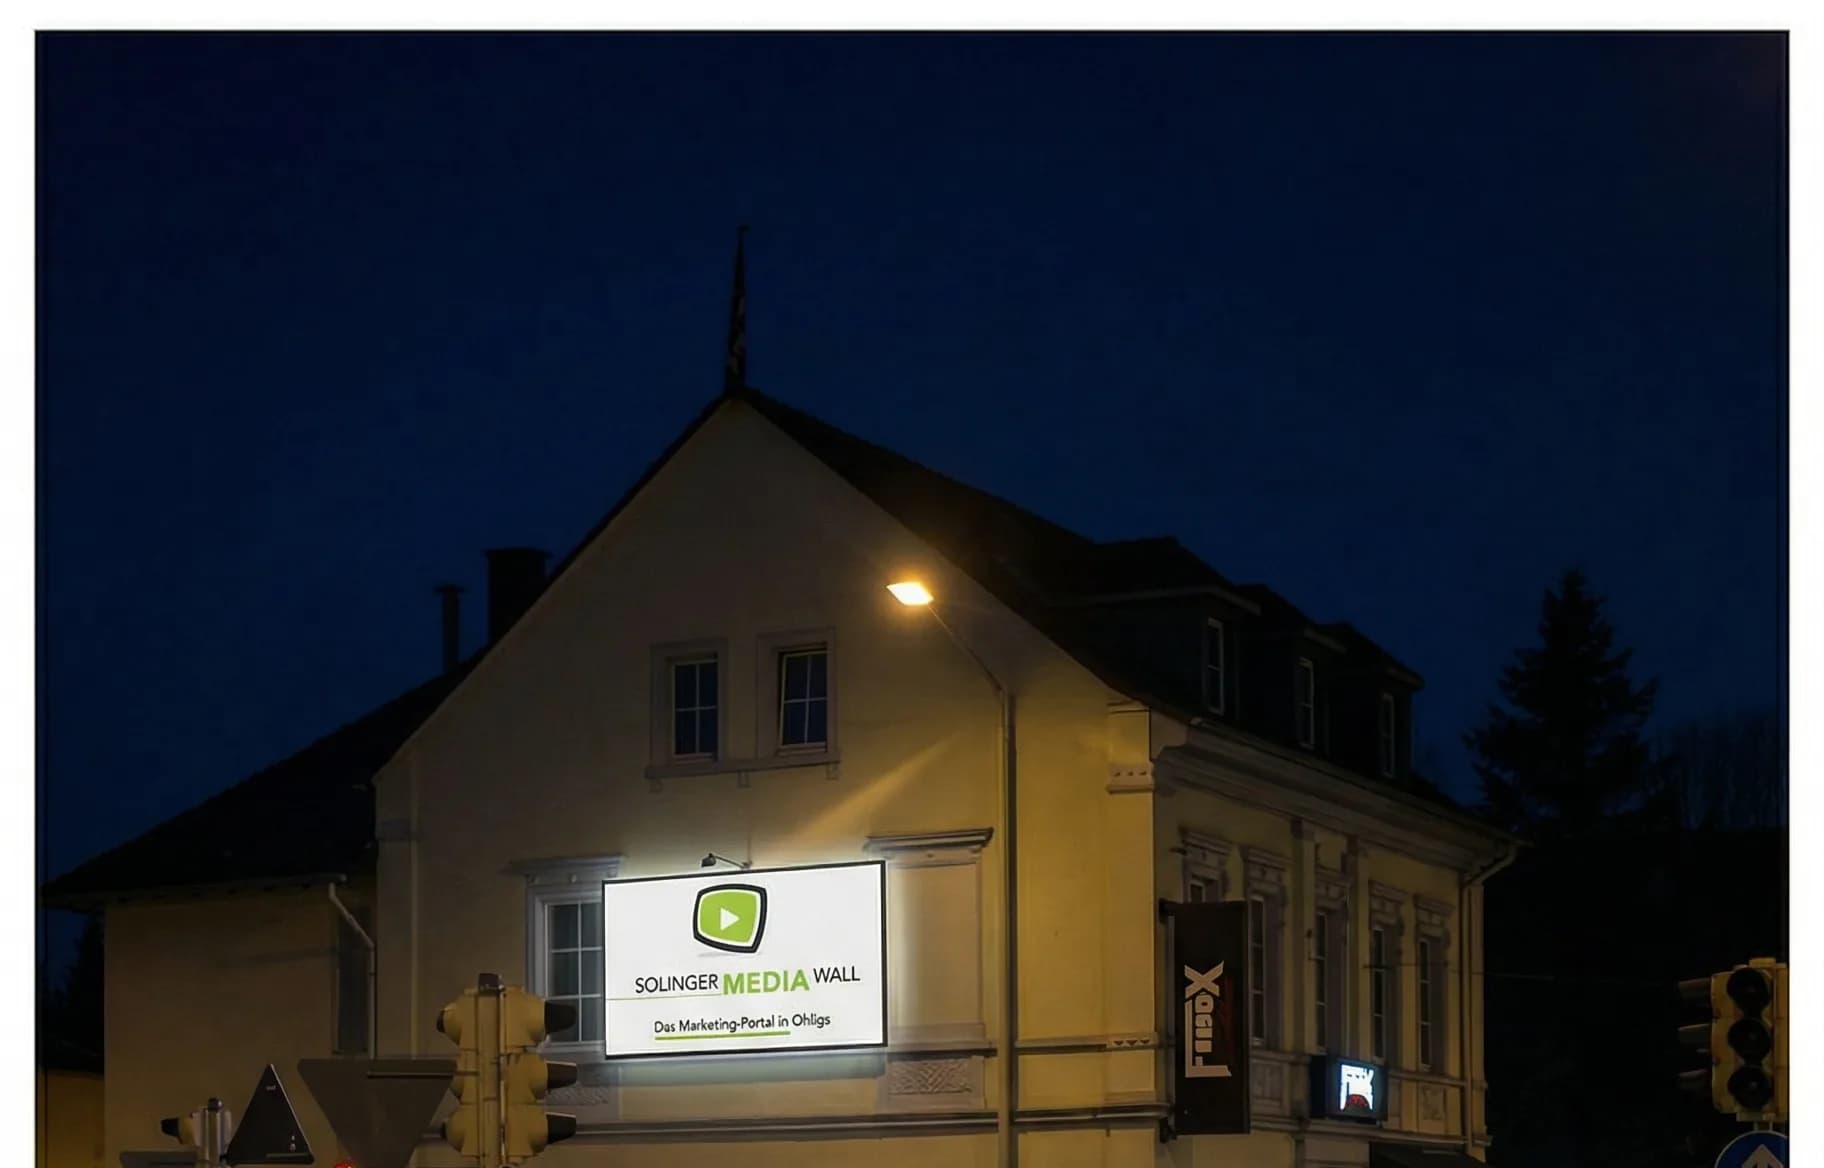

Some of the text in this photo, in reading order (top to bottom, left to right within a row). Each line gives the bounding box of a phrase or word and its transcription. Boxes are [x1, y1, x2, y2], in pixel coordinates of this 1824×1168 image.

[635, 965, 861, 995] SOLINGER MEDIA WALL
[654, 1013, 831, 1033] Das Marketing-Portal in Ohligs
